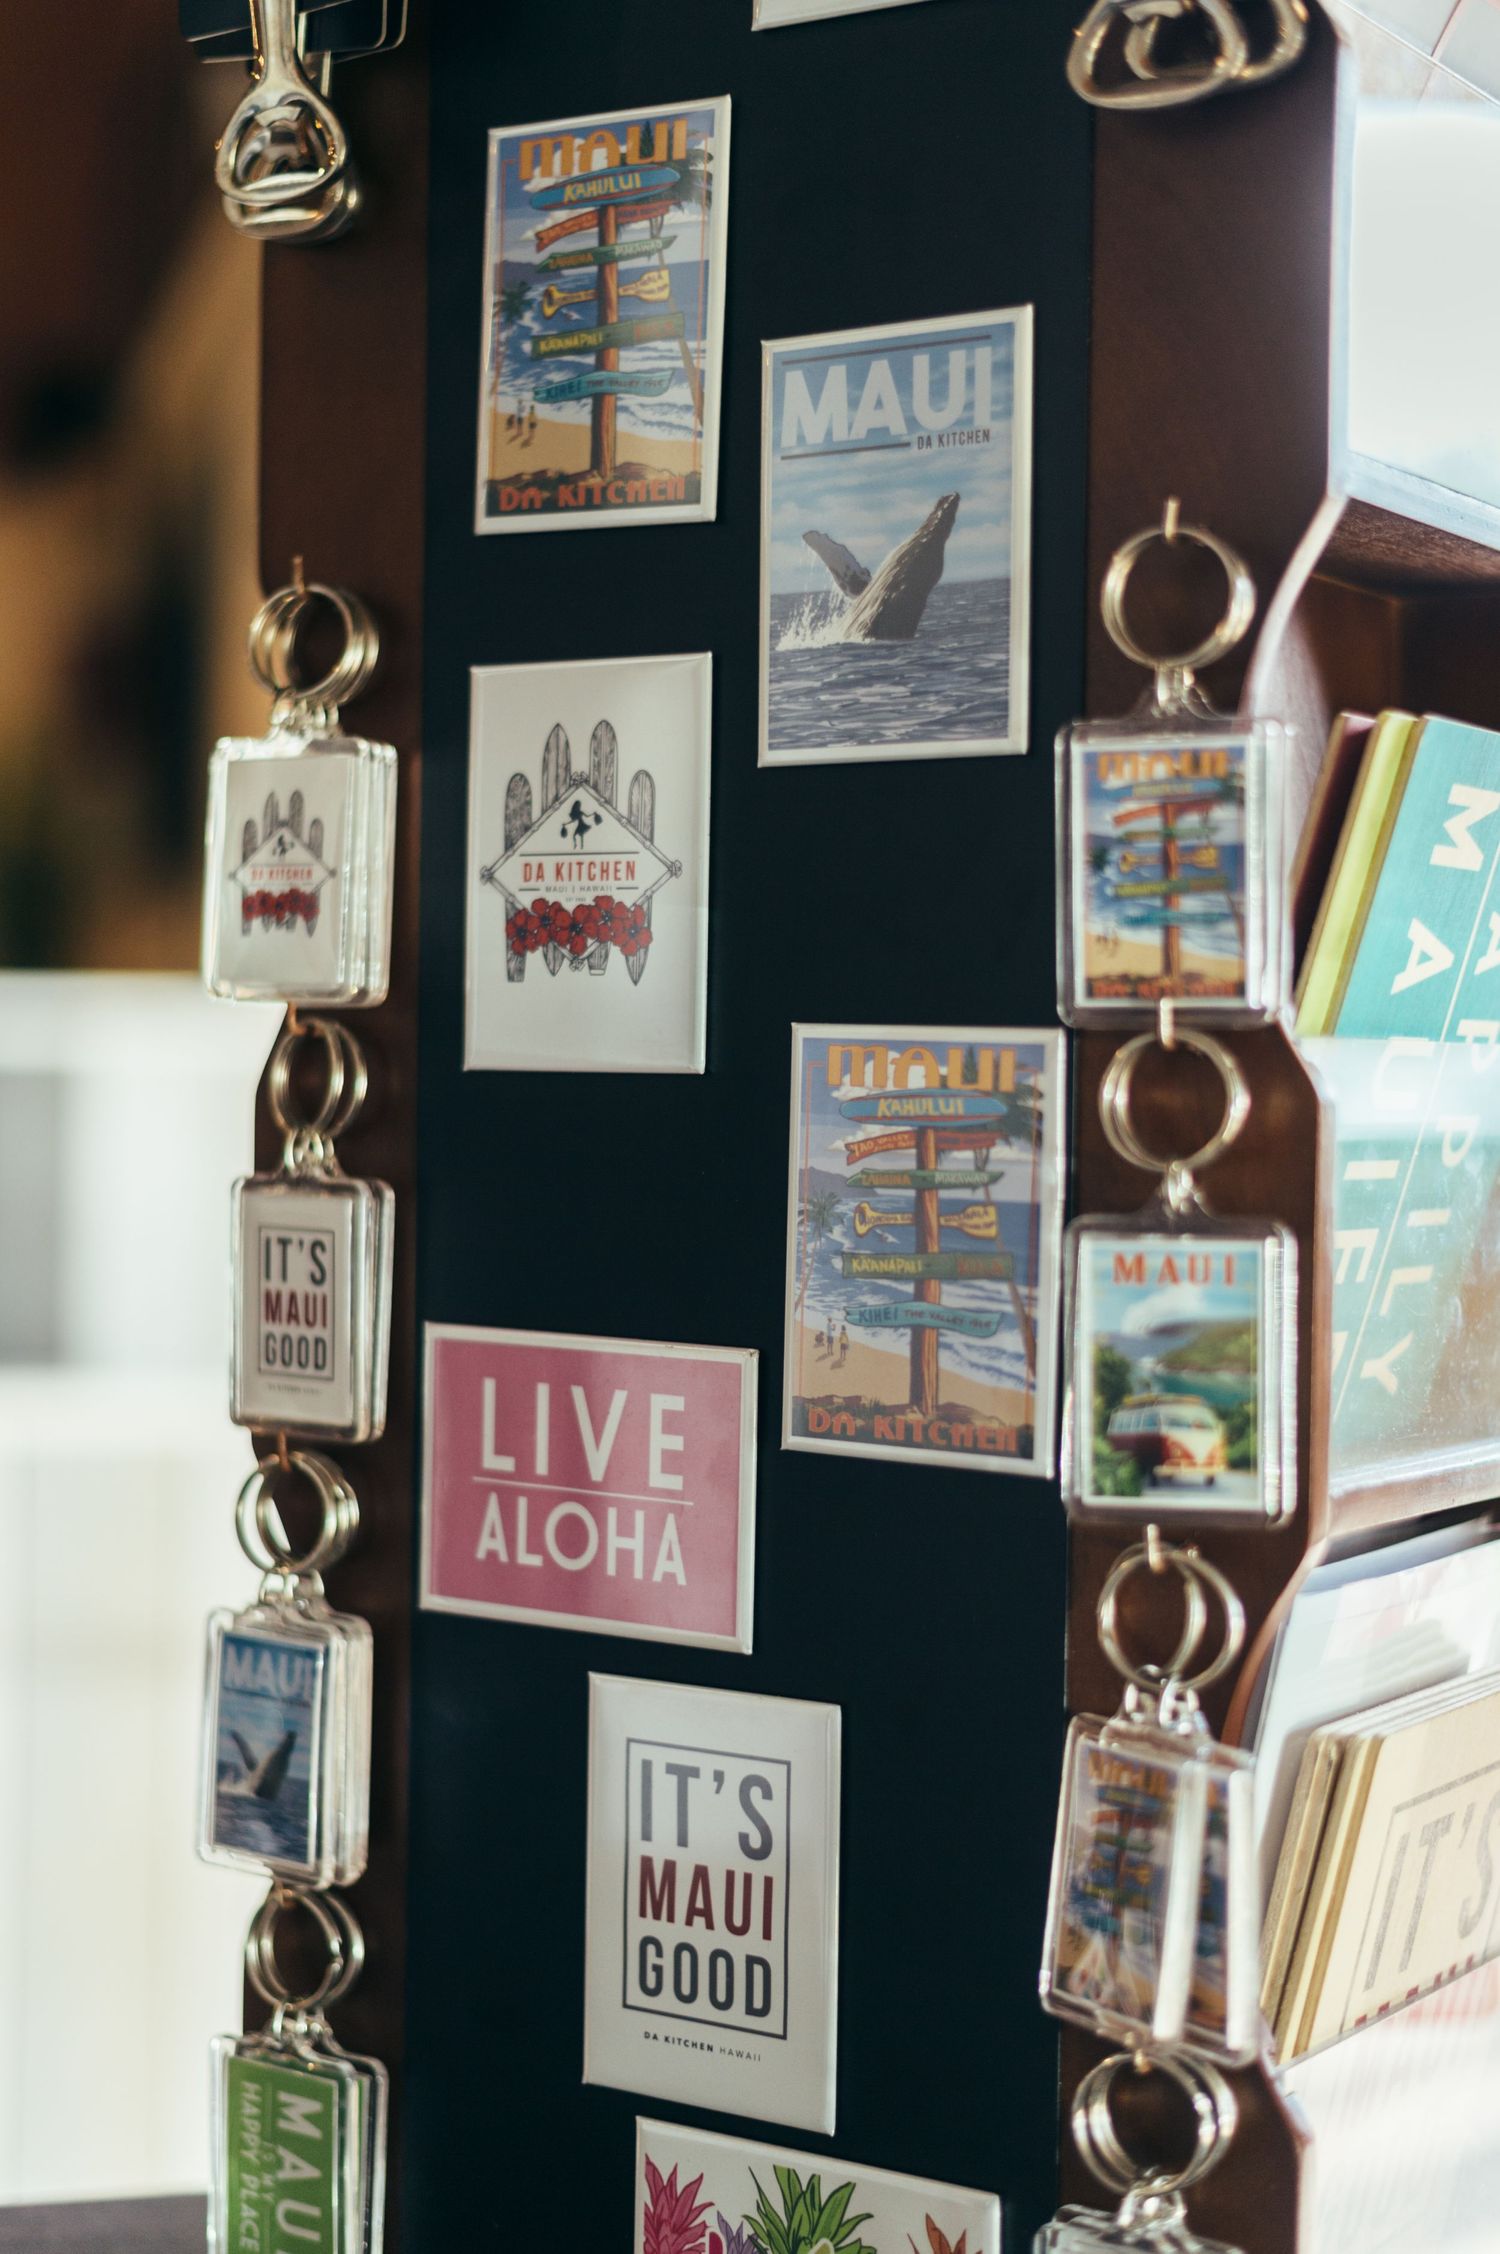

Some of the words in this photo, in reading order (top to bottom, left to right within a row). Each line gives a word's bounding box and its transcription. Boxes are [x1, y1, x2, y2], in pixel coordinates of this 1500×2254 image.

[519, 118, 688, 181] MAUI
[563, 172, 642, 204] KAHULUI
[780, 346, 992, 449] MAUI
[917, 435, 932, 450] DA
[937, 429, 991, 448] KITCHEN
[500, 487, 543, 511] DA
[558, 476, 686, 507] KITCHEN
[523, 862, 545, 882] DA
[555, 860, 636, 881] KITCHEN
[827, 1044, 1017, 1093] MAUI
[877, 1097, 965, 1118] KAHULUI
[264, 1235, 328, 1287] IT'S
[1113, 1252, 1235, 1285] MAUI
[264, 1289, 328, 1329] MAUI
[264, 1332, 328, 1371] GOOD
[481, 1376, 685, 1491] LIVE
[808, 1407, 857, 1437] DA
[874, 1414, 1018, 1453] KITCHEN
[475, 1491, 688, 1586] ALOHA
[224, 1643, 314, 1697] MAUI
[638, 1854, 774, 1941] MAUI
[638, 1935, 773, 2018] GOOD
[644, 2031, 658, 2041] DA
[664, 2035, 714, 2052] KITCHEN
[719, 2046, 761, 2061] HAWAII
[240, 2080, 264, 2166] HAPPY
[275, 2089, 324, 2254] MAU
[239, 2172, 262, 2251] PLACE
